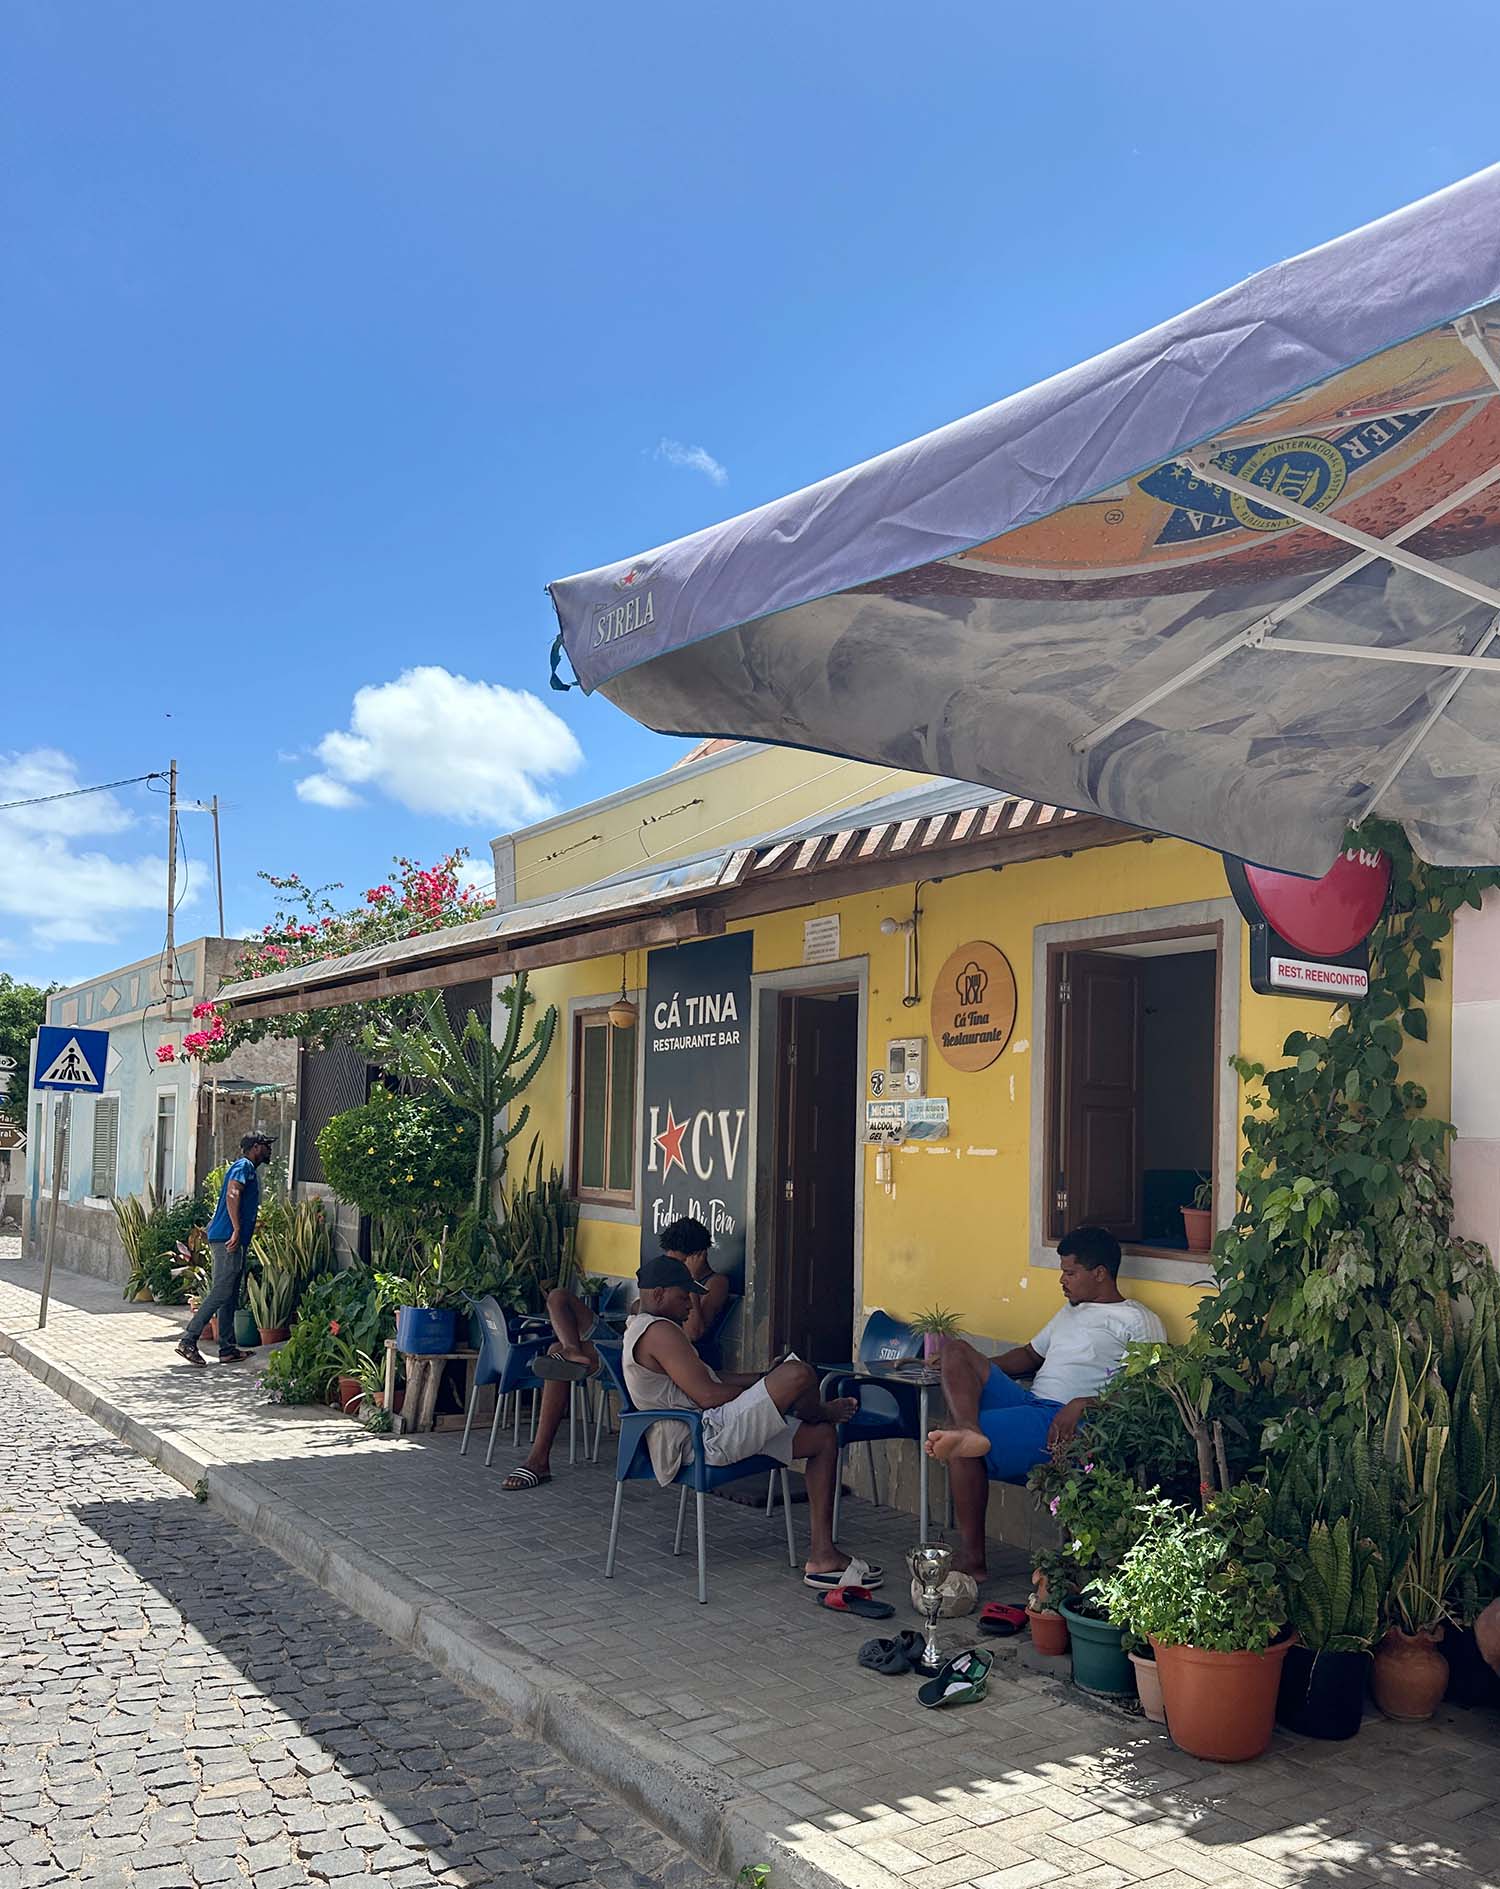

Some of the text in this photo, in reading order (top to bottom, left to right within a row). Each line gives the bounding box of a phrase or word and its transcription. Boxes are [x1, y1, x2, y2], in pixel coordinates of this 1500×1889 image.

[593, 591, 654, 649] STRELA
[1278, 964, 1367, 987] REST. REENCONTRO
[653, 990, 738, 1031] CÁ TINA
[954, 1010, 990, 1029] Cá Tina
[653, 1030, 740, 1053] RESTAURANTE BAR
[942, 1028, 1002, 1048] Restaurante
[869, 1121, 894, 1131] ALCOOL
[869, 1132, 883, 1141] GEL
[690, 1108, 745, 1181] CV
